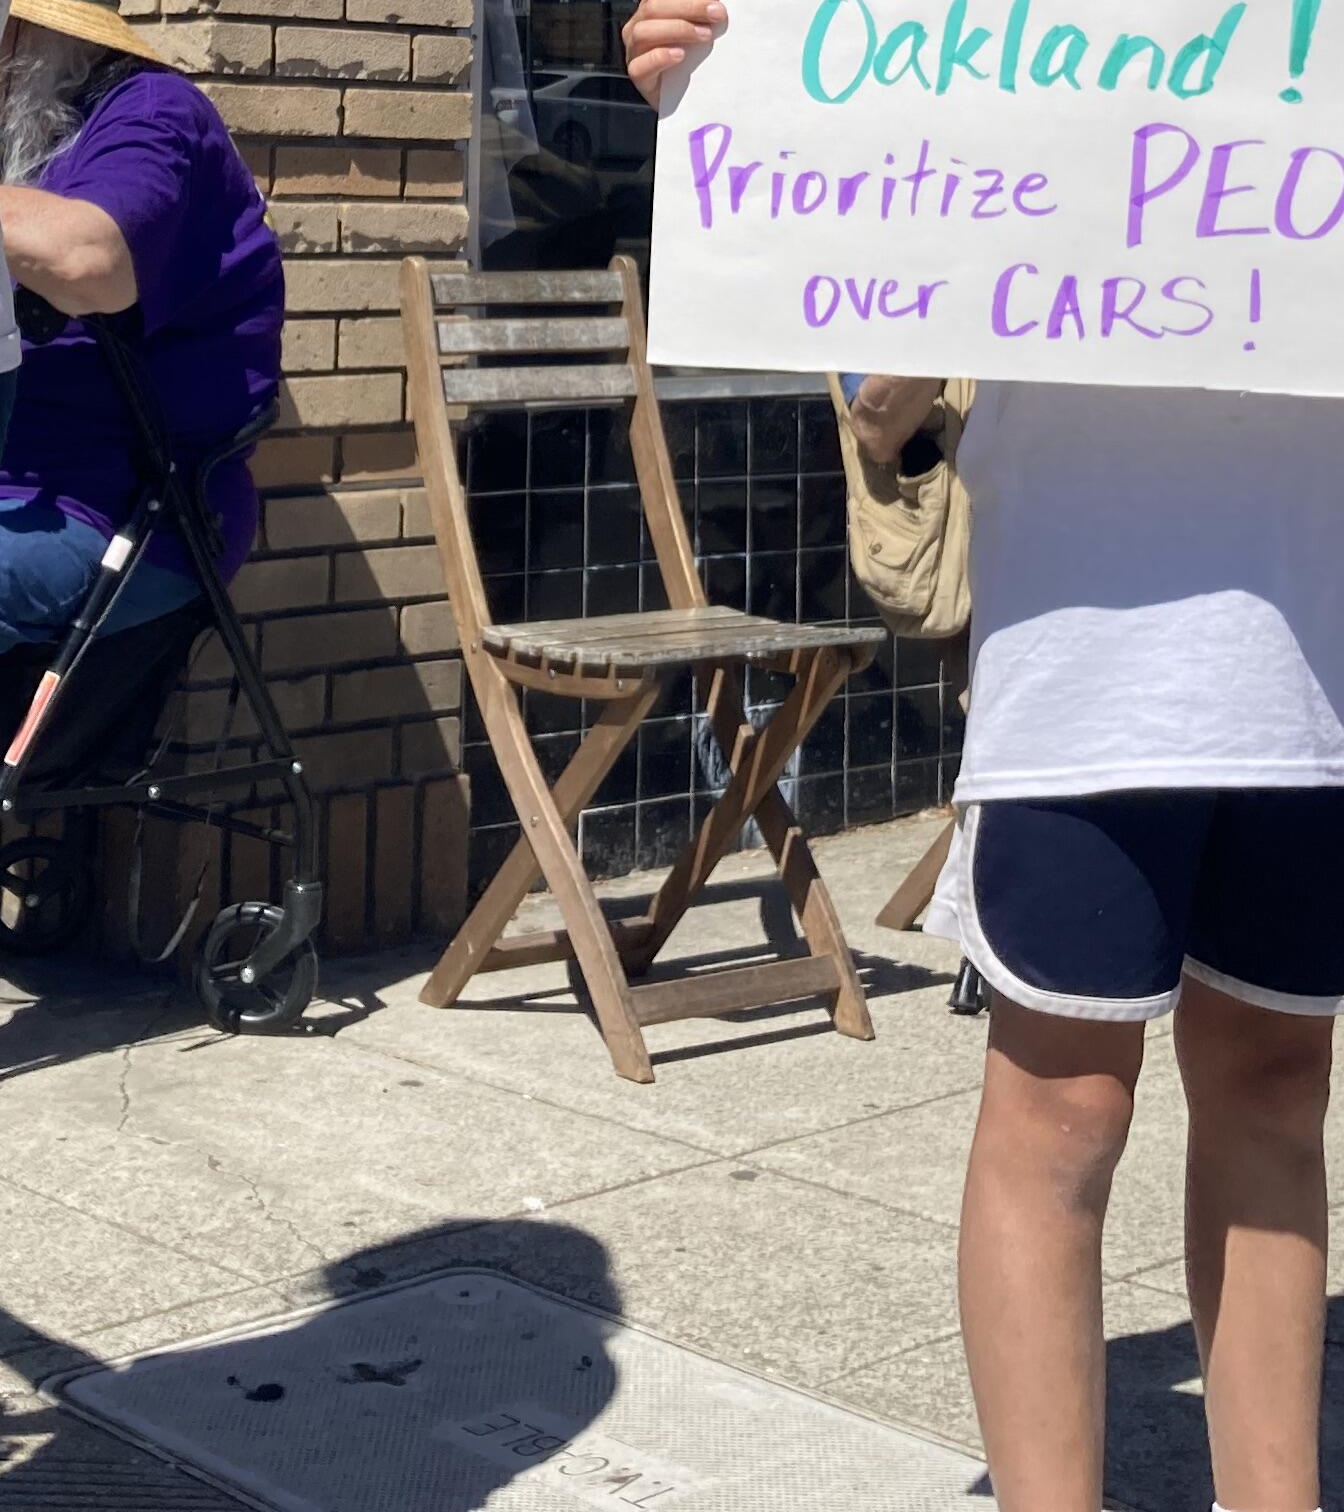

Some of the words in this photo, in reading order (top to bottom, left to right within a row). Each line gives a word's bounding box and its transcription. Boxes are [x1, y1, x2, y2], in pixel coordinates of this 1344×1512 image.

[687, 121, 1057, 230] Prioritize
[803, 273, 948, 328] over
[991, 263, 1262, 352] CARS!
